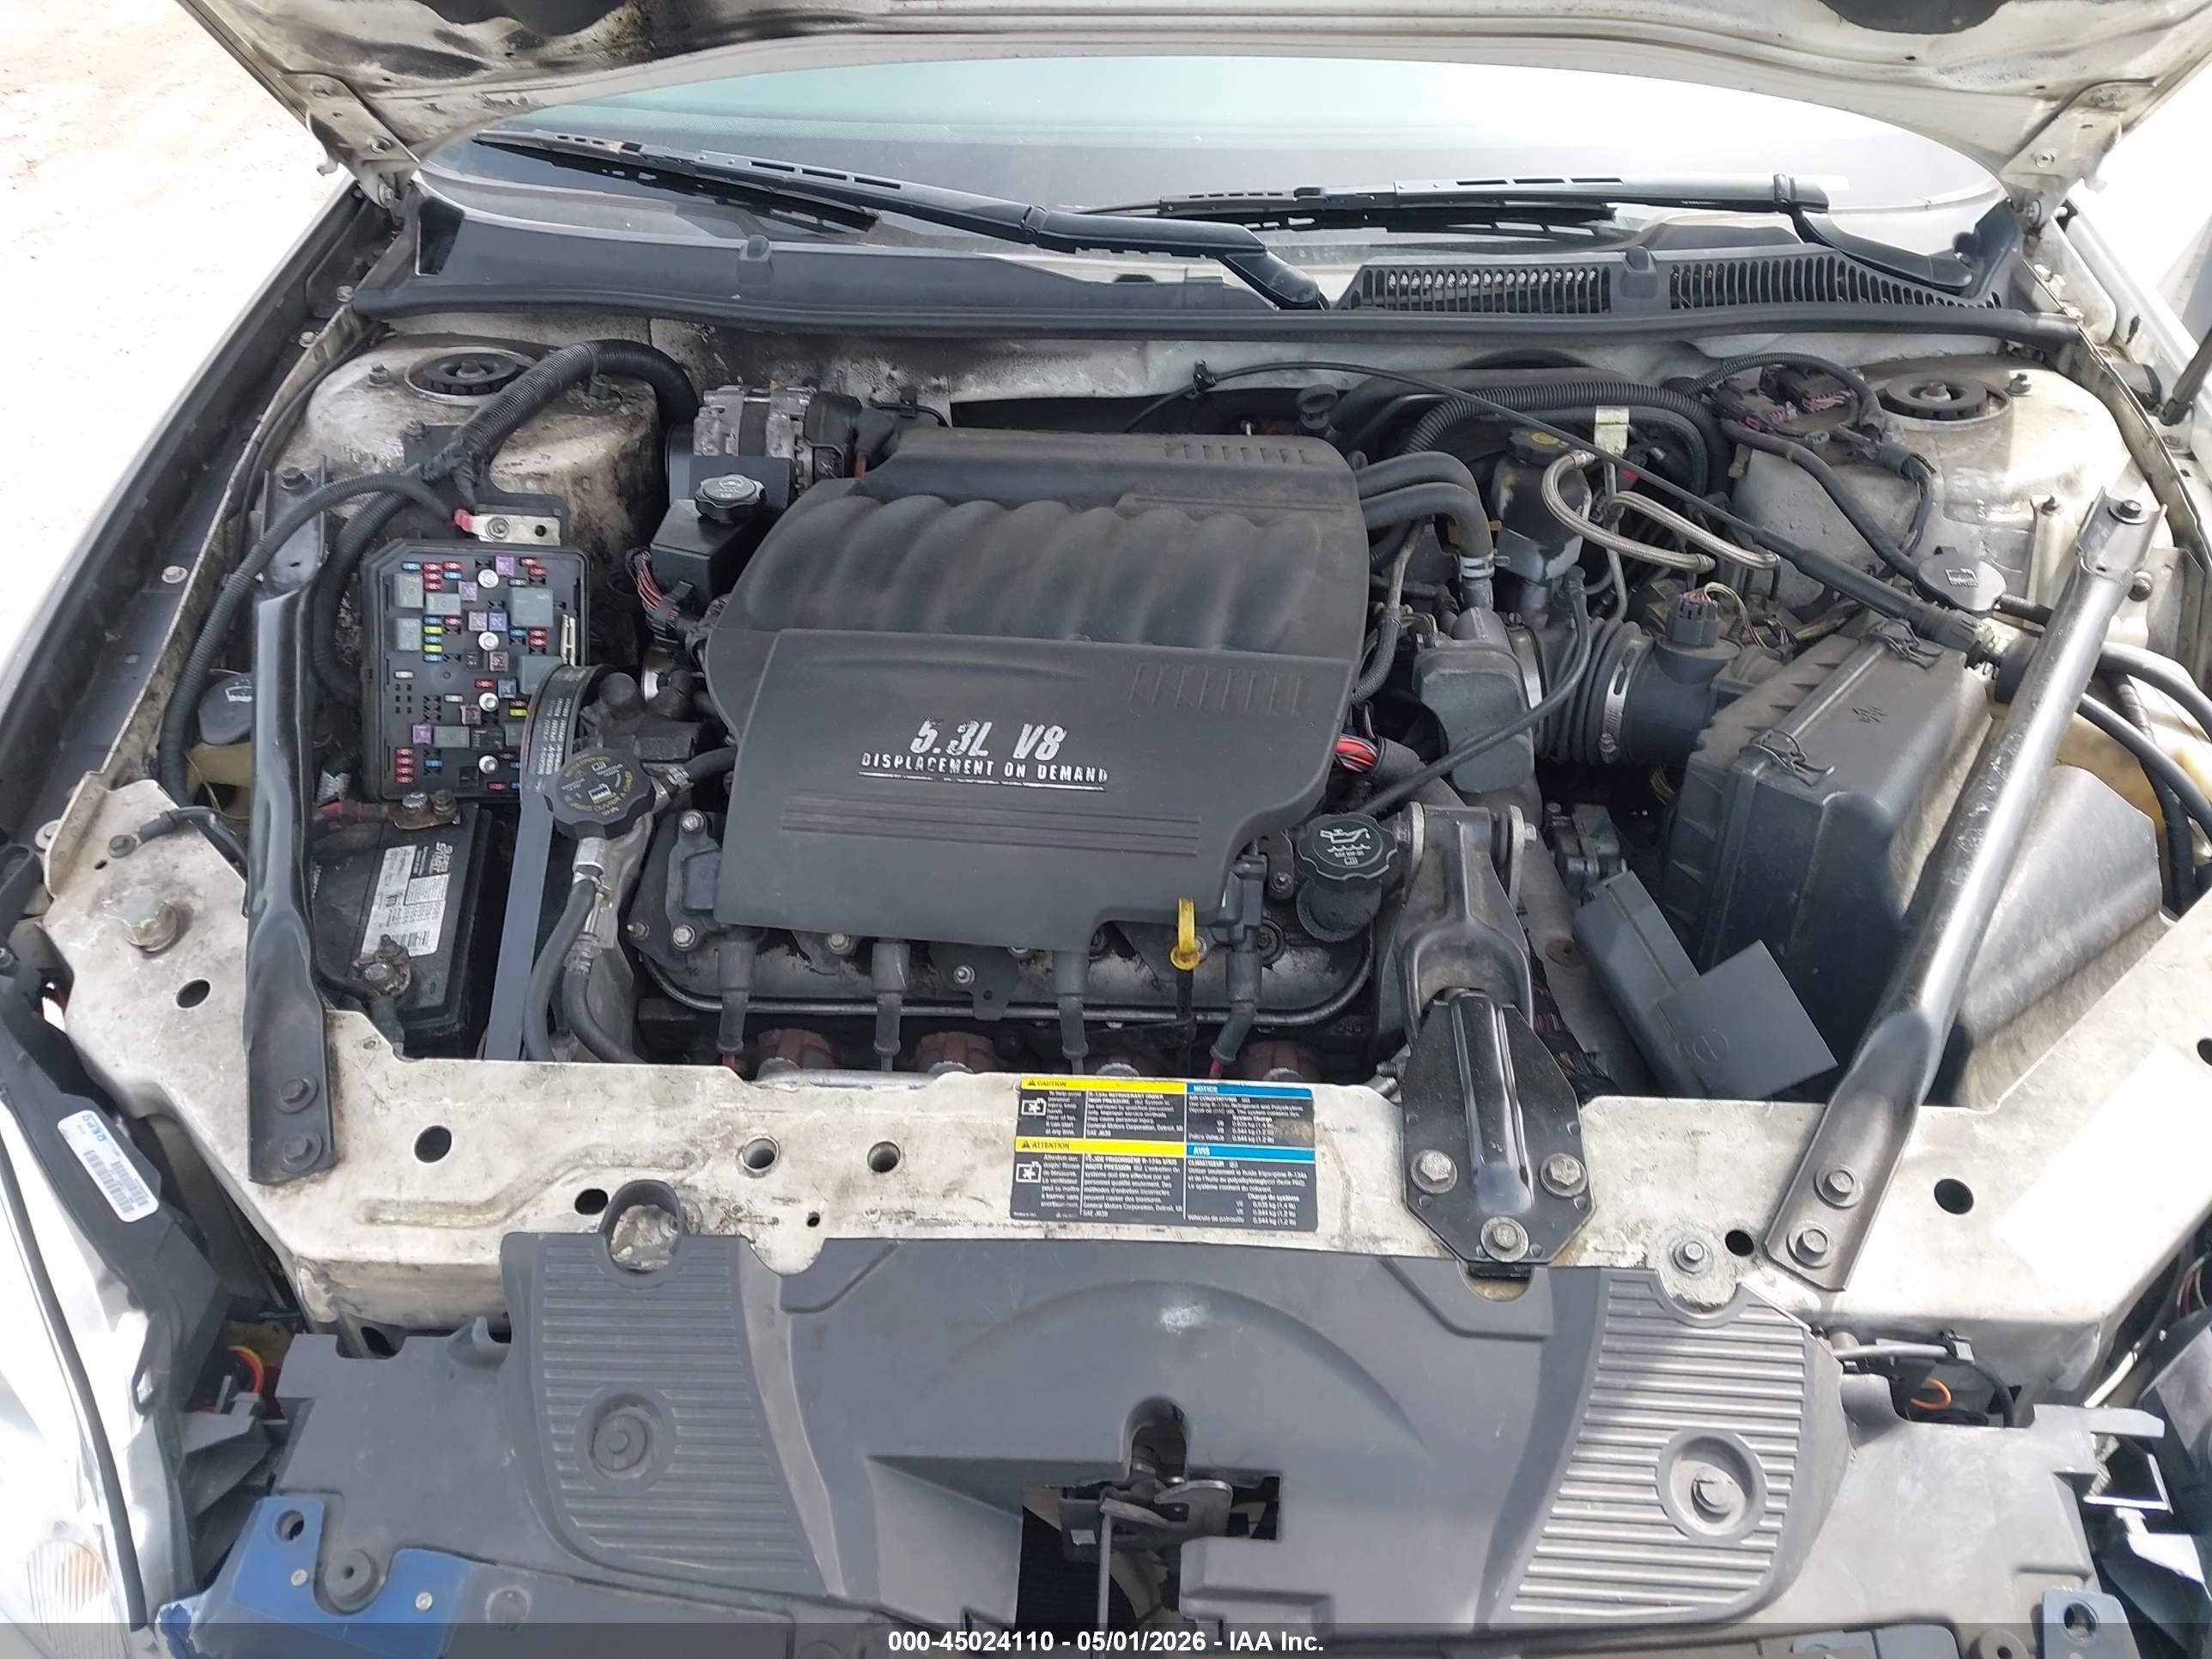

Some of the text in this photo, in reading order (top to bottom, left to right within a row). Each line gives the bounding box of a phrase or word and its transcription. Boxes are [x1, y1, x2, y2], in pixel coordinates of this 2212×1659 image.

[909, 718, 1067, 762] 5.3L V8
[860, 752, 1109, 784] DISPLACEMENT ON DEMAND
[1193, 1146, 1210, 1155] AVIS
